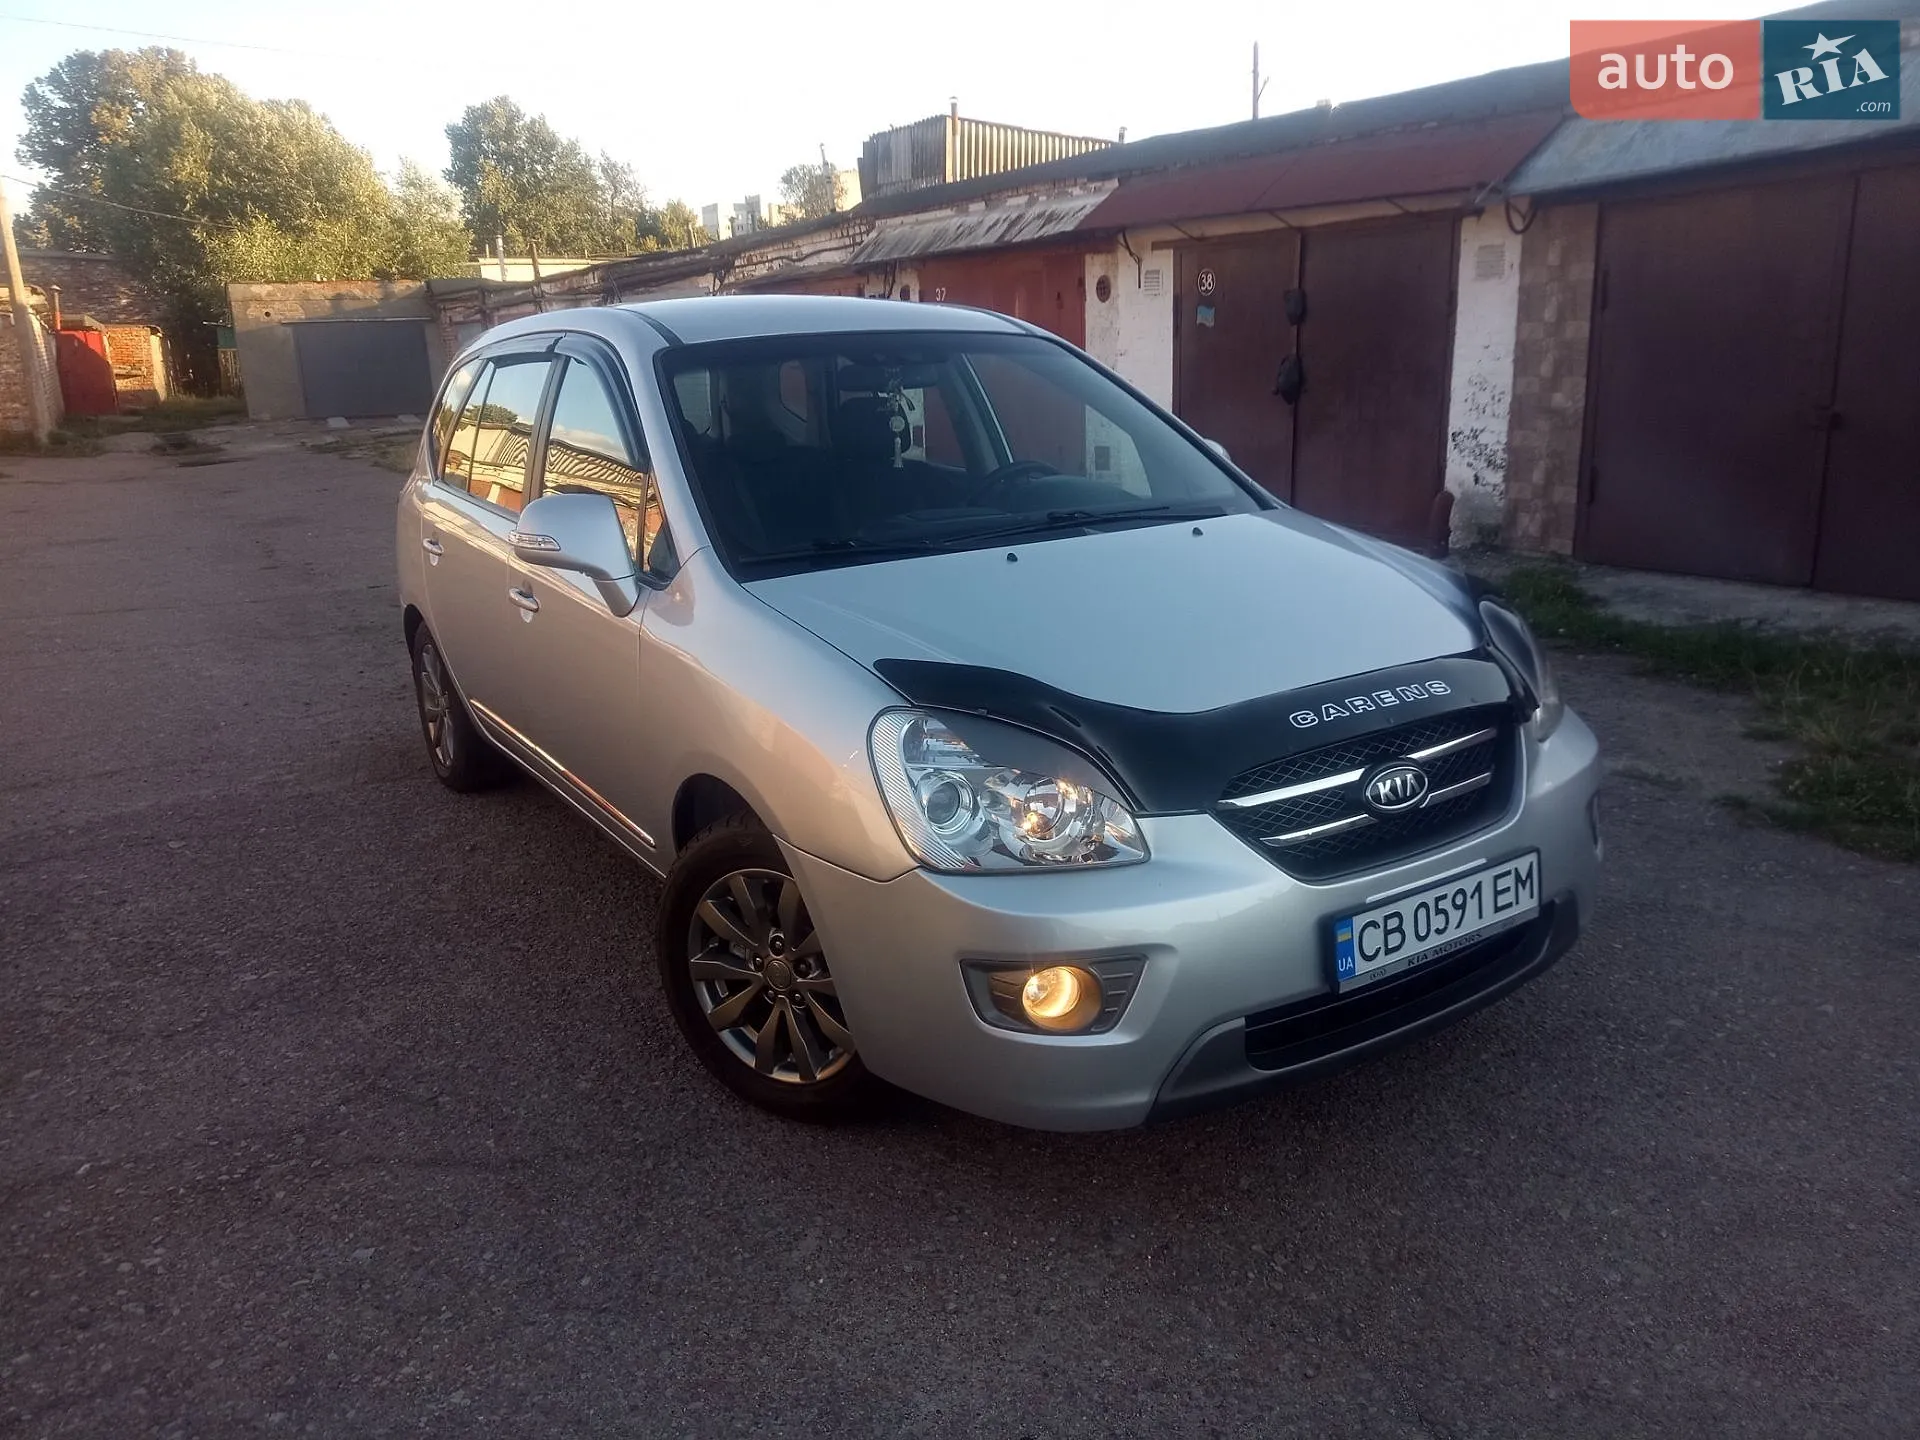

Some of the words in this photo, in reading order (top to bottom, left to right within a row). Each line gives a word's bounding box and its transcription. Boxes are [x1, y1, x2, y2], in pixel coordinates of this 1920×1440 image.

[935, 287, 946, 301] 37
[1200, 273, 1213, 290] 38
[1289, 680, 1452, 728] CARENS
[1376, 772, 1420, 804] KIA
[1358, 911, 1406, 962] CB
[1413, 880, 1483, 942] 0591
[1492, 861, 1534, 914] EM
[1338, 958, 1354, 972] UA
[1407, 953, 1428, 966] KIA
[1431, 933, 1482, 957] MOTORS
